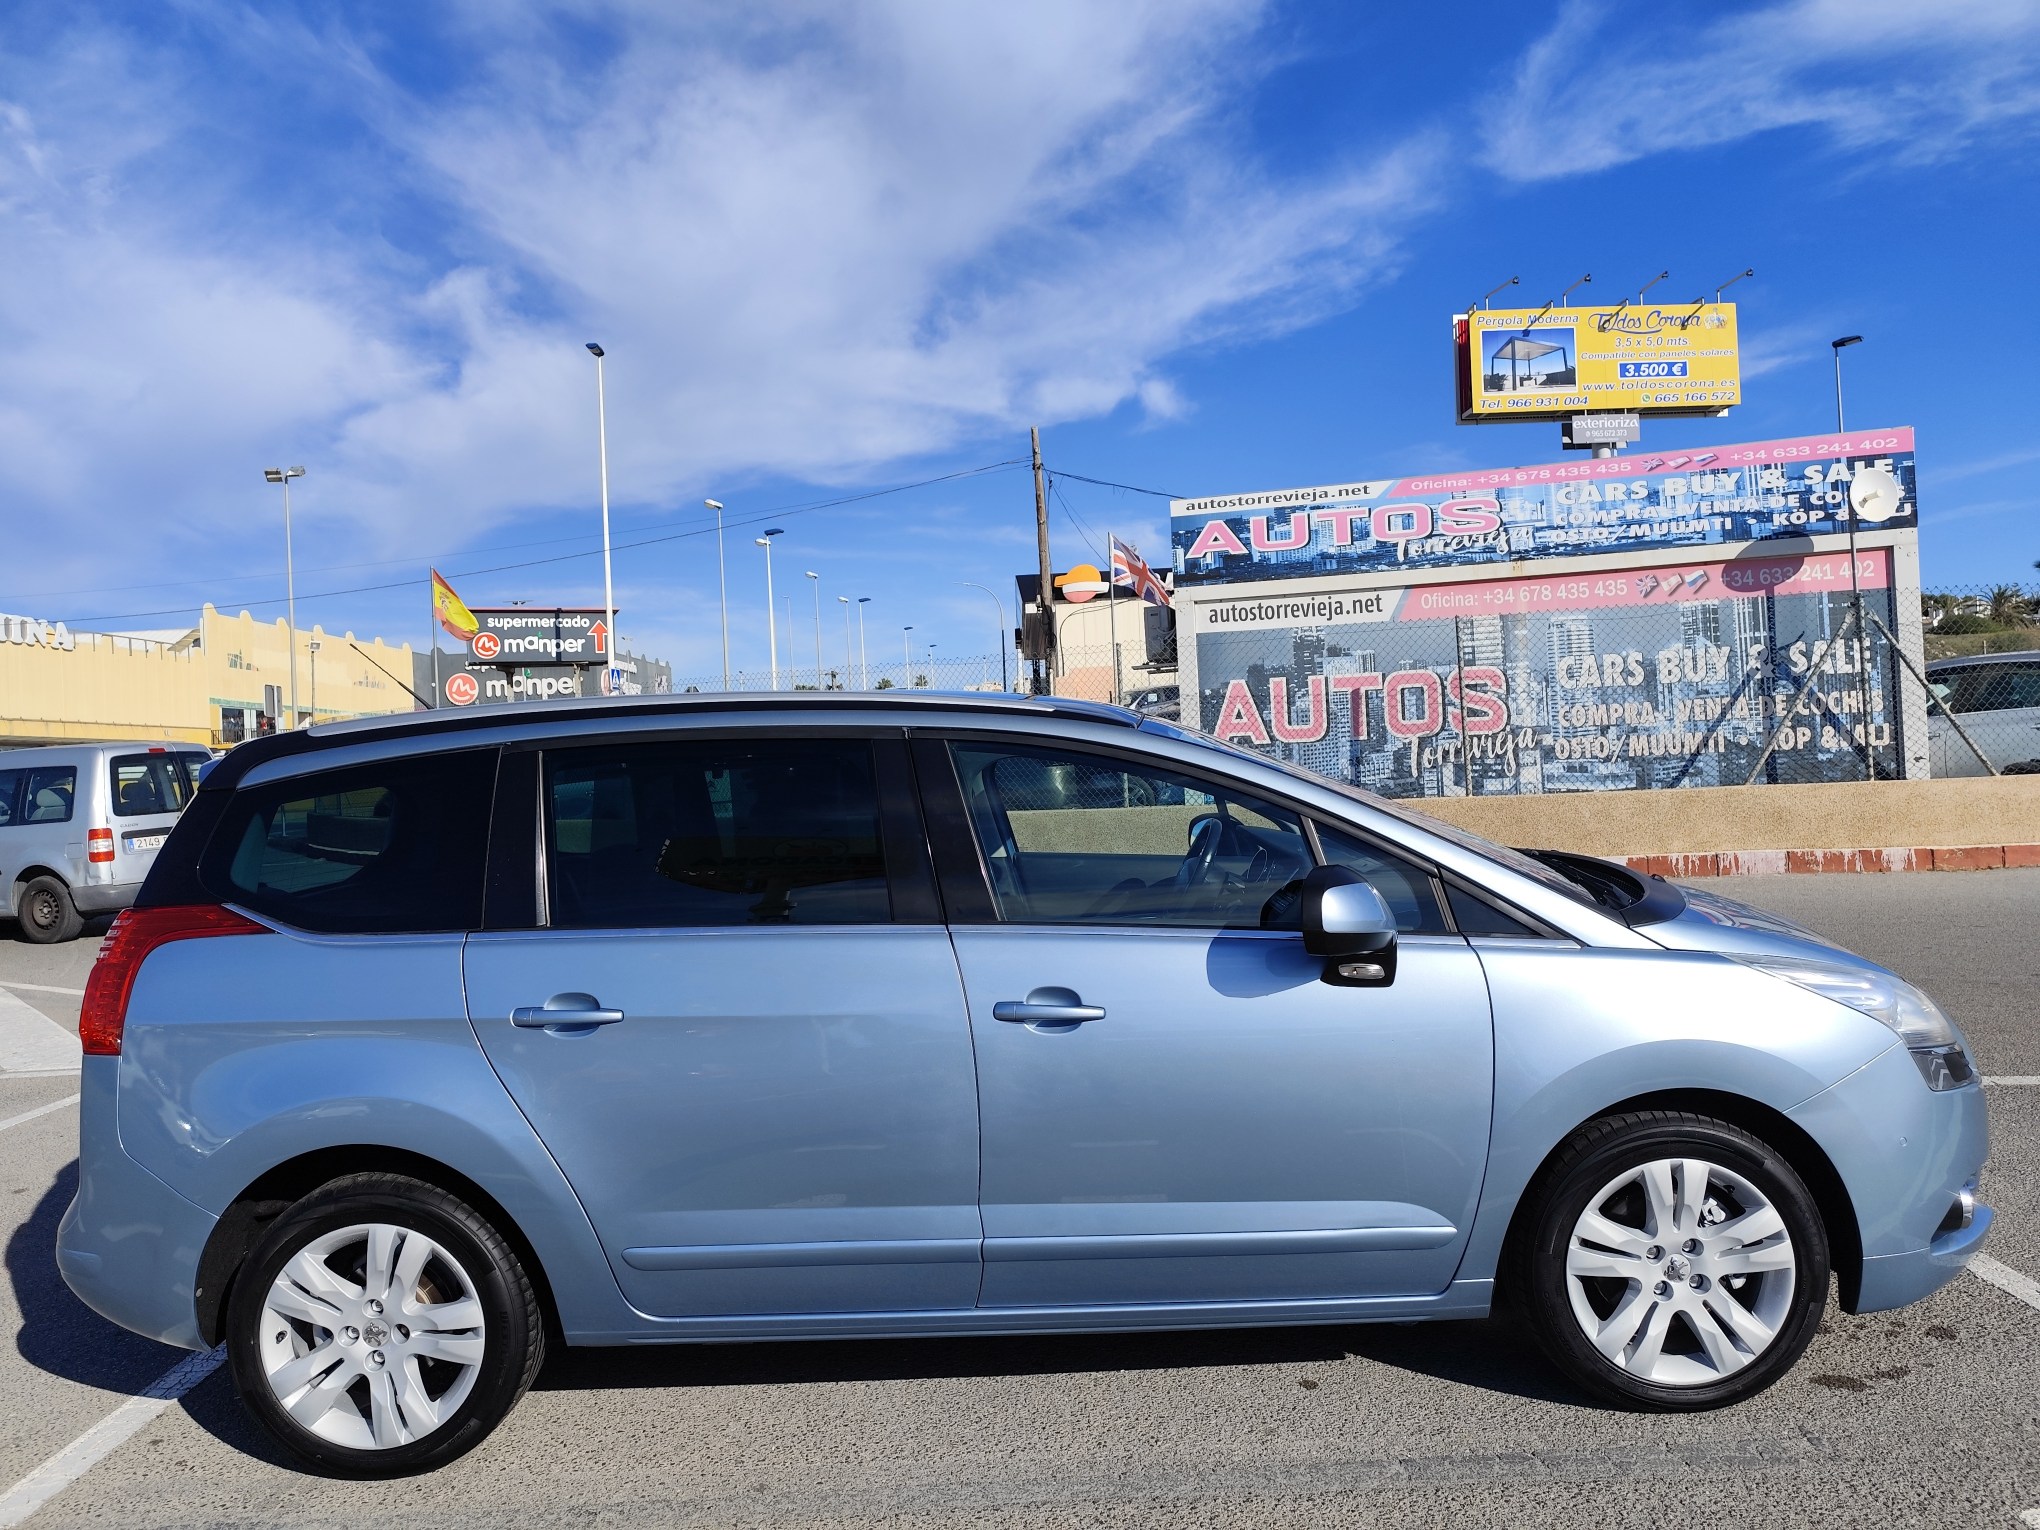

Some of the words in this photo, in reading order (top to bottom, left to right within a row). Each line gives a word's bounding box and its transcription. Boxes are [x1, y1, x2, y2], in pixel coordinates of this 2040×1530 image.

[1527, 314, 1579, 325] Moderna
[1646, 310, 1701, 330] Corona
[1580, 351, 1636, 360] Compatible
[1659, 350, 1697, 360] paneles
[1699, 348, 1734, 357] solares
[1615, 337, 1632, 348] 3,5
[1635, 339, 1642, 347] x
[1646, 336, 1664, 347] 5,0
[1624, 363, 1669, 377] 3.500
[1671, 363, 1684, 376] €
[1582, 379, 1736, 391] www.toldoscorona.es
[1655, 393, 1680, 403] 665
[1684, 392, 1707, 402] 166
[1711, 391, 1735, 401] 572
[1480, 400, 1503, 409] Tel.
[1507, 398, 1532, 408] 966
[1536, 397, 1559, 407] 931
[1563, 395, 1588, 406] 004
[1573, 416, 1639, 429] exterioriza
[1730, 450, 1767, 461] +34
[1773, 446, 1811, 457] 633
[1816, 442, 1855, 454] 241
[1860, 437, 1899, 450] 402
[1411, 478, 1472, 490] Oficina:
[1477, 473, 1511, 484] +34
[1516, 470, 1551, 481] 678
[1556, 465, 1591, 477] 435
[1596, 462, 1632, 474] 435
[1556, 479, 1649, 505] CARS
[1664, 471, 1742, 497] BUY
[1760, 469, 1788, 489] &
[1185, 484, 1370, 511] autostorrevieja.net
[1556, 504, 1659, 525] COMPRA
[1683, 497, 1761, 516] VENTA
[1770, 493, 1800, 509] DE
[1184, 498, 1503, 559] AUTOS
[1773, 508, 1826, 526] KÖP
[1721, 570, 1754, 587] +34
[1759, 566, 1795, 585] 633
[1800, 563, 1834, 581] 241
[1421, 593, 1478, 609] Oficina:
[1483, 587, 1515, 605] +34
[1519, 584, 1552, 602] 678
[1556, 582, 1590, 600] 435
[1594, 579, 1628, 597] 435
[1208, 593, 1384, 623] autostorrevieja.net
[487, 614, 590, 631] supermercado
[504, 634, 586, 658] manper
[1558, 651, 1646, 690] CARS
[1658, 645, 1731, 686] BUY
[1748, 643, 1777, 680] &
[1789, 637, 1873, 676] SALE
[1213, 665, 1510, 746] AUTOS
[1558, 701, 1659, 728] COMPRA
[1678, 691, 1751, 721] VENTA
[1758, 694, 1788, 718] DE
[1796, 690, 1884, 717] COCHS
[1404, 724, 1539, 778] Torrvieja
[136, 837, 161, 848] 2149
